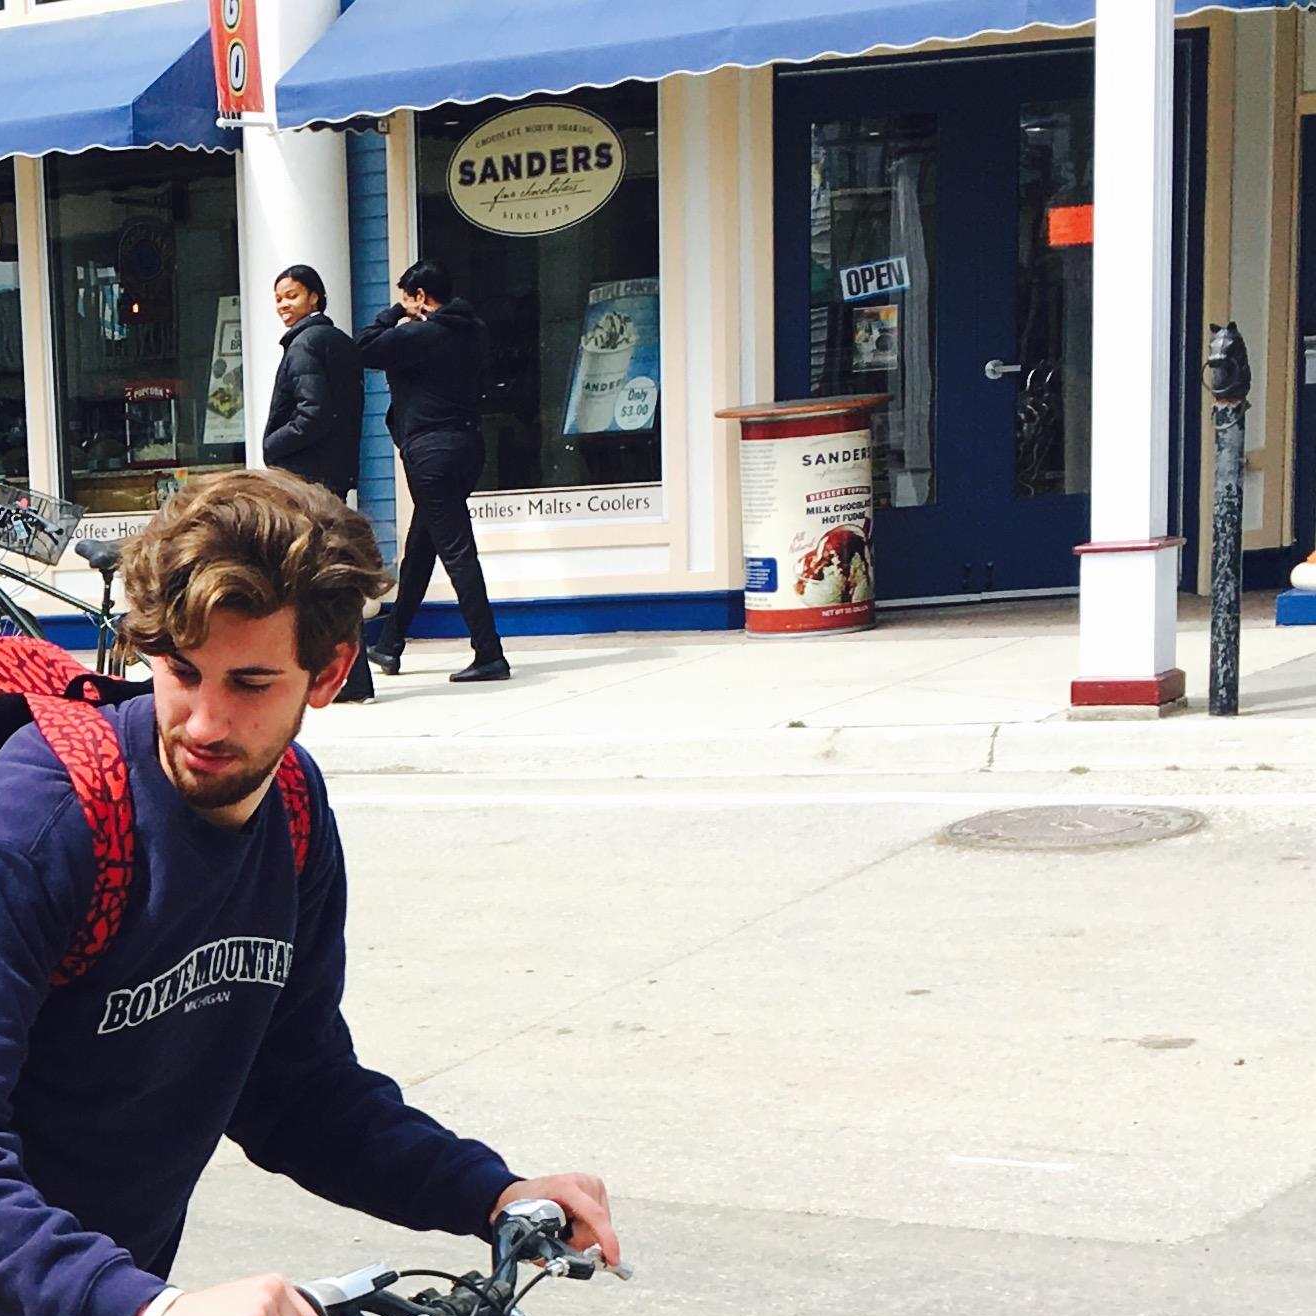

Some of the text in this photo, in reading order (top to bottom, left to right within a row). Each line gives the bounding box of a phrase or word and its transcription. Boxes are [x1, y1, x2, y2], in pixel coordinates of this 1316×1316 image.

[458, 142, 613, 187] SANDERS
[846, 260, 904, 296] OPEN
[628, 388, 648, 402] Only
[621, 404, 649, 417] $3.00
[469, 494, 651, 519] othies Malts Coolers
[806, 505, 831, 515] MILK
[822, 514, 841, 524] HOT
